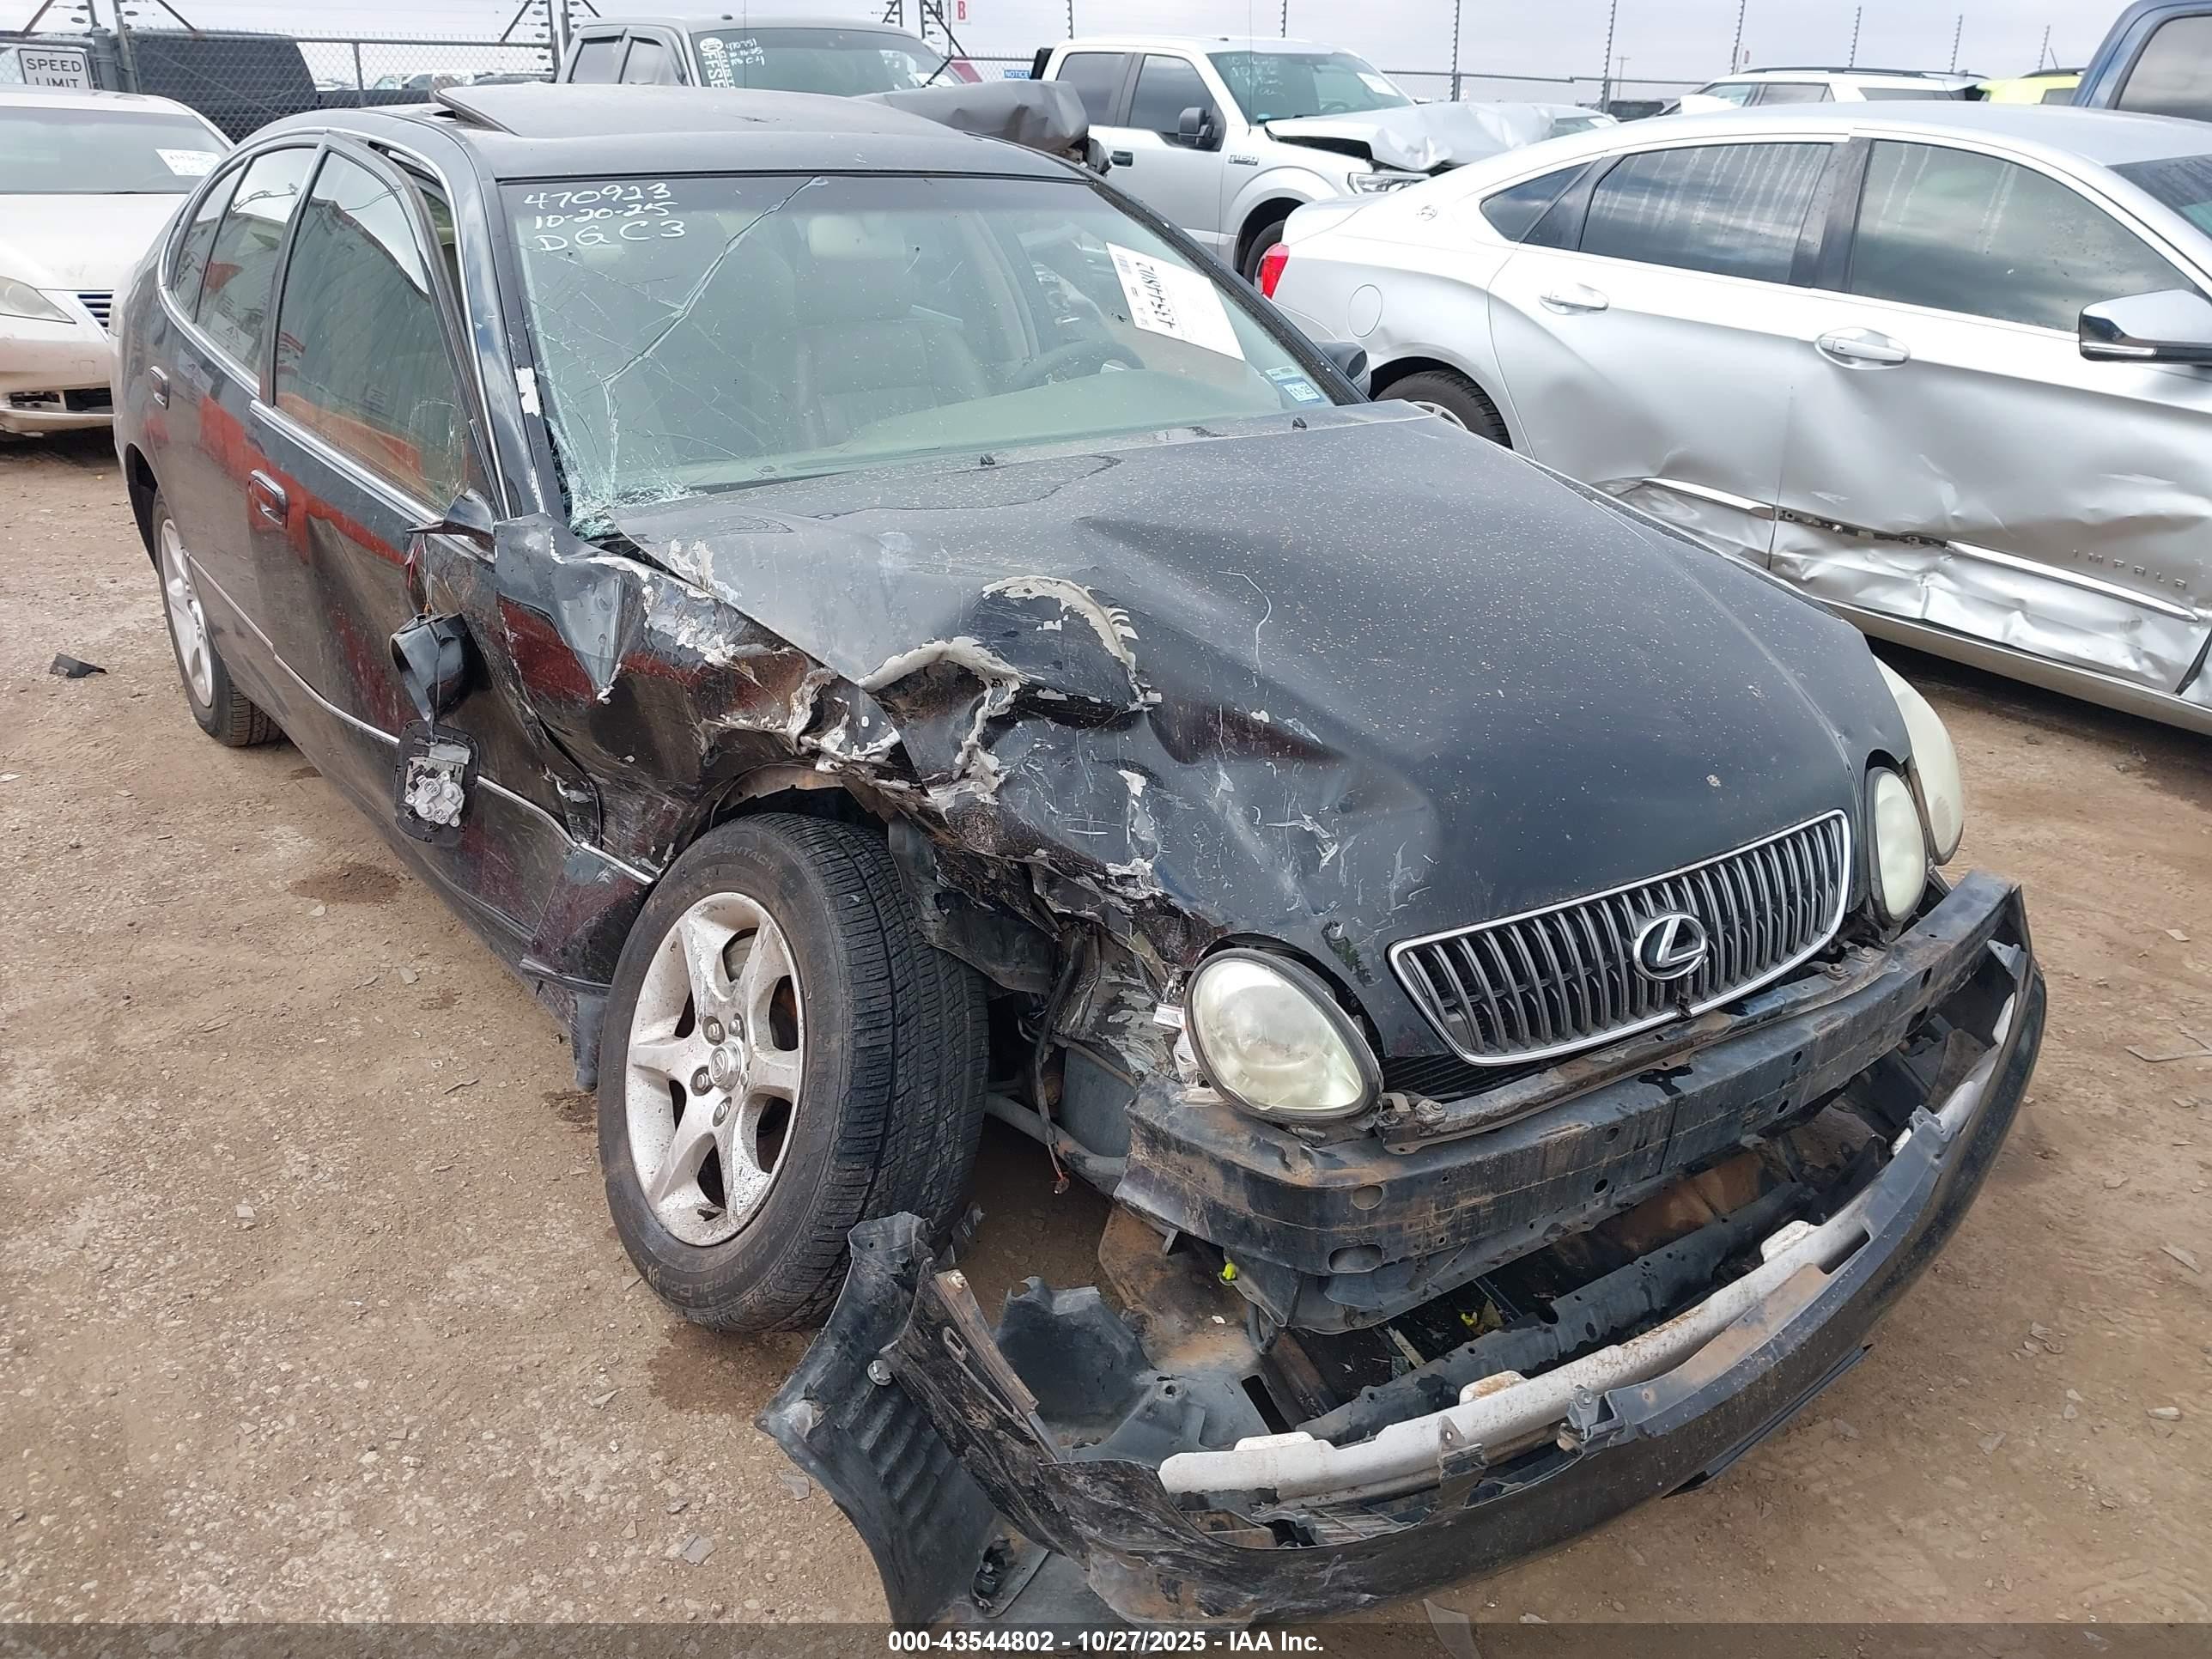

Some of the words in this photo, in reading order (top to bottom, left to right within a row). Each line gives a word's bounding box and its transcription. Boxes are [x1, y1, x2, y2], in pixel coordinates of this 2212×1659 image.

[957, 1, 966, 20] B
[26, 58, 83, 73] SPEED
[524, 182, 672, 210] 470923
[535, 202, 679, 230] 10-20-25
[2072, 549, 2187, 590] IMPALA
